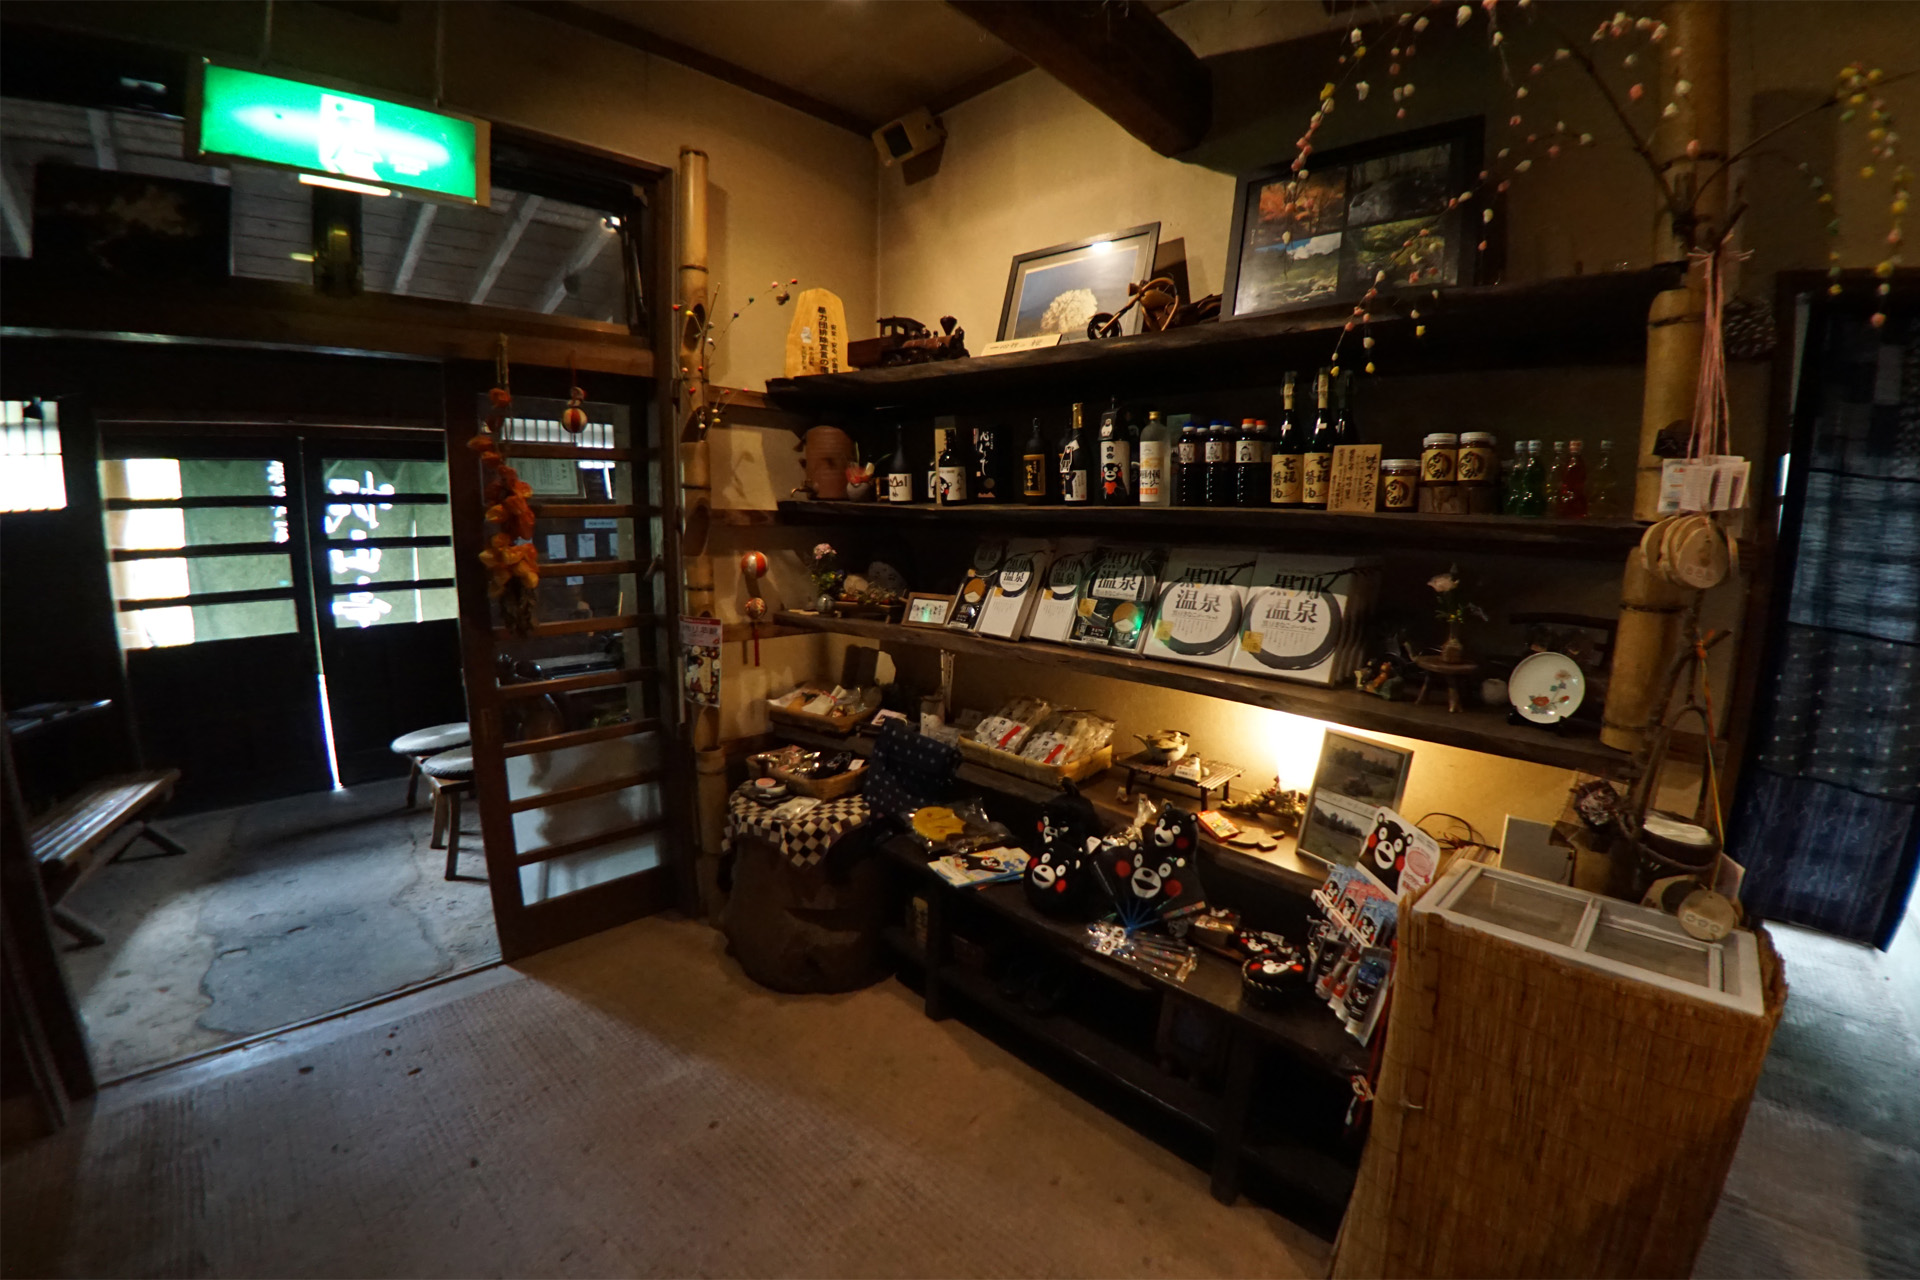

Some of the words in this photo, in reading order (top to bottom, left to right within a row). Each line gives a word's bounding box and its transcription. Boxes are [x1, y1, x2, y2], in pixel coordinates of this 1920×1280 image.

[1004, 571, 1025, 583] 温泉
[1098, 569, 1137, 591] 温泉
[1178, 567, 1229, 589] 黒川
[1269, 574, 1323, 599] 黒川
[1175, 589, 1221, 613] 温泉
[1265, 599, 1318, 624] 温泉
